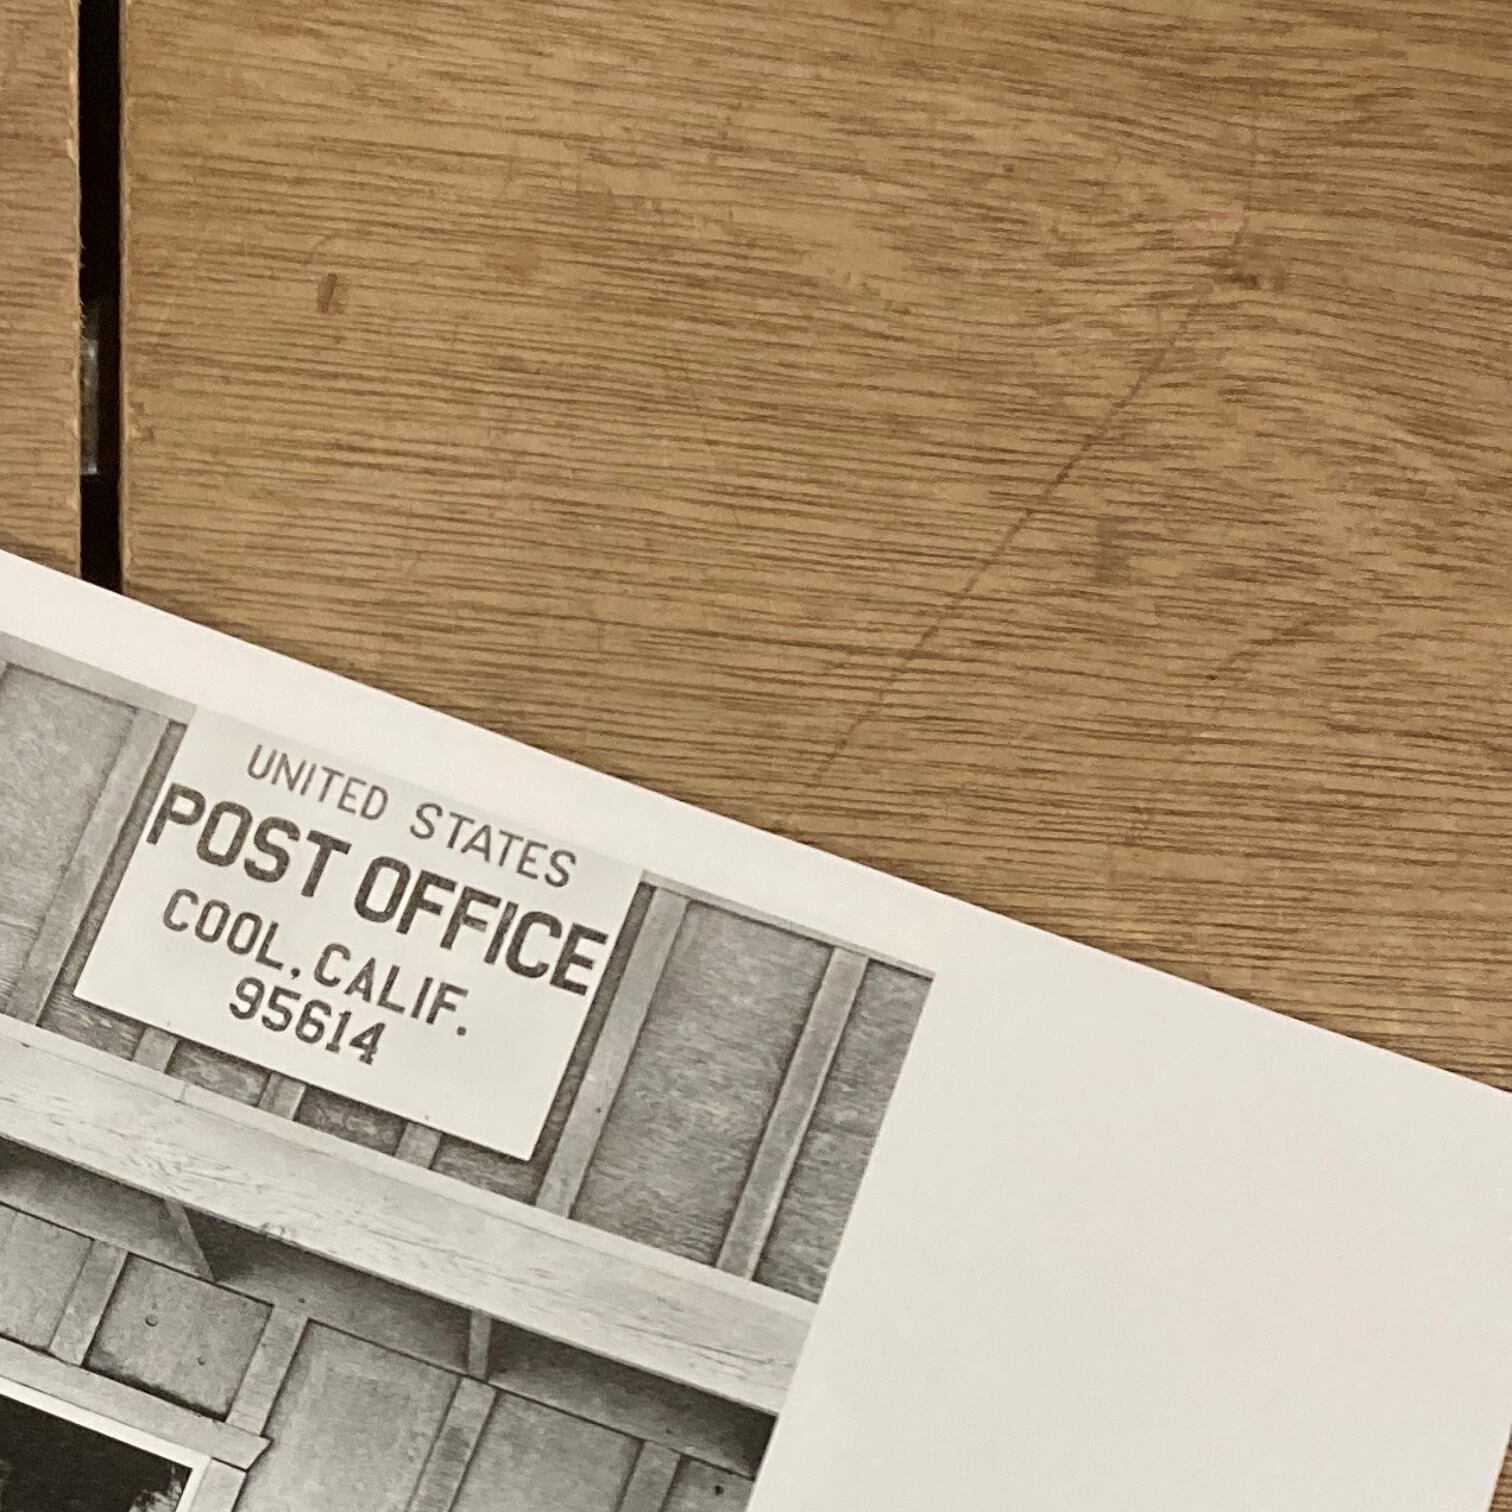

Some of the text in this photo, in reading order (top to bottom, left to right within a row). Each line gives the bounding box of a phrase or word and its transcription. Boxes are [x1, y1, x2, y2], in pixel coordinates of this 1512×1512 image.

[247, 743, 577, 888] UNITED STATES
[145, 782, 608, 997] POST OFFICE
[163, 888, 469, 1037] COOL, CALIF.
[228, 975, 387, 1066] 95614
